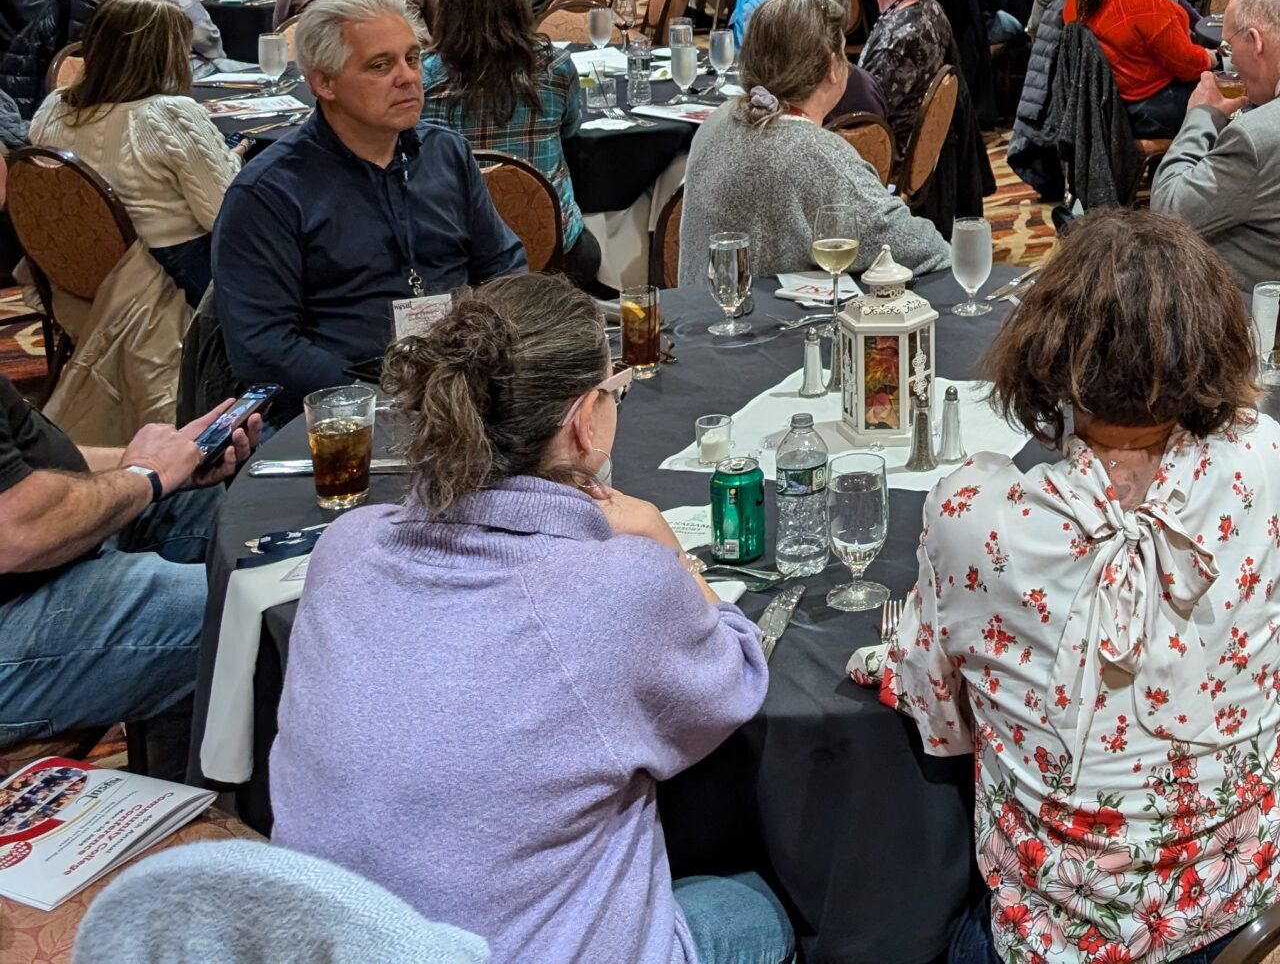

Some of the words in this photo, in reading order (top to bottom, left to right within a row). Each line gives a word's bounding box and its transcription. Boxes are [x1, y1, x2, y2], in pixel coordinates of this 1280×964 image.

[75, 777, 124, 806] nysut
[78, 804, 143, 855] Conference
[108, 792, 175, 842] Community
[105, 829, 134, 854] Annual
[64, 842, 109, 875] College
